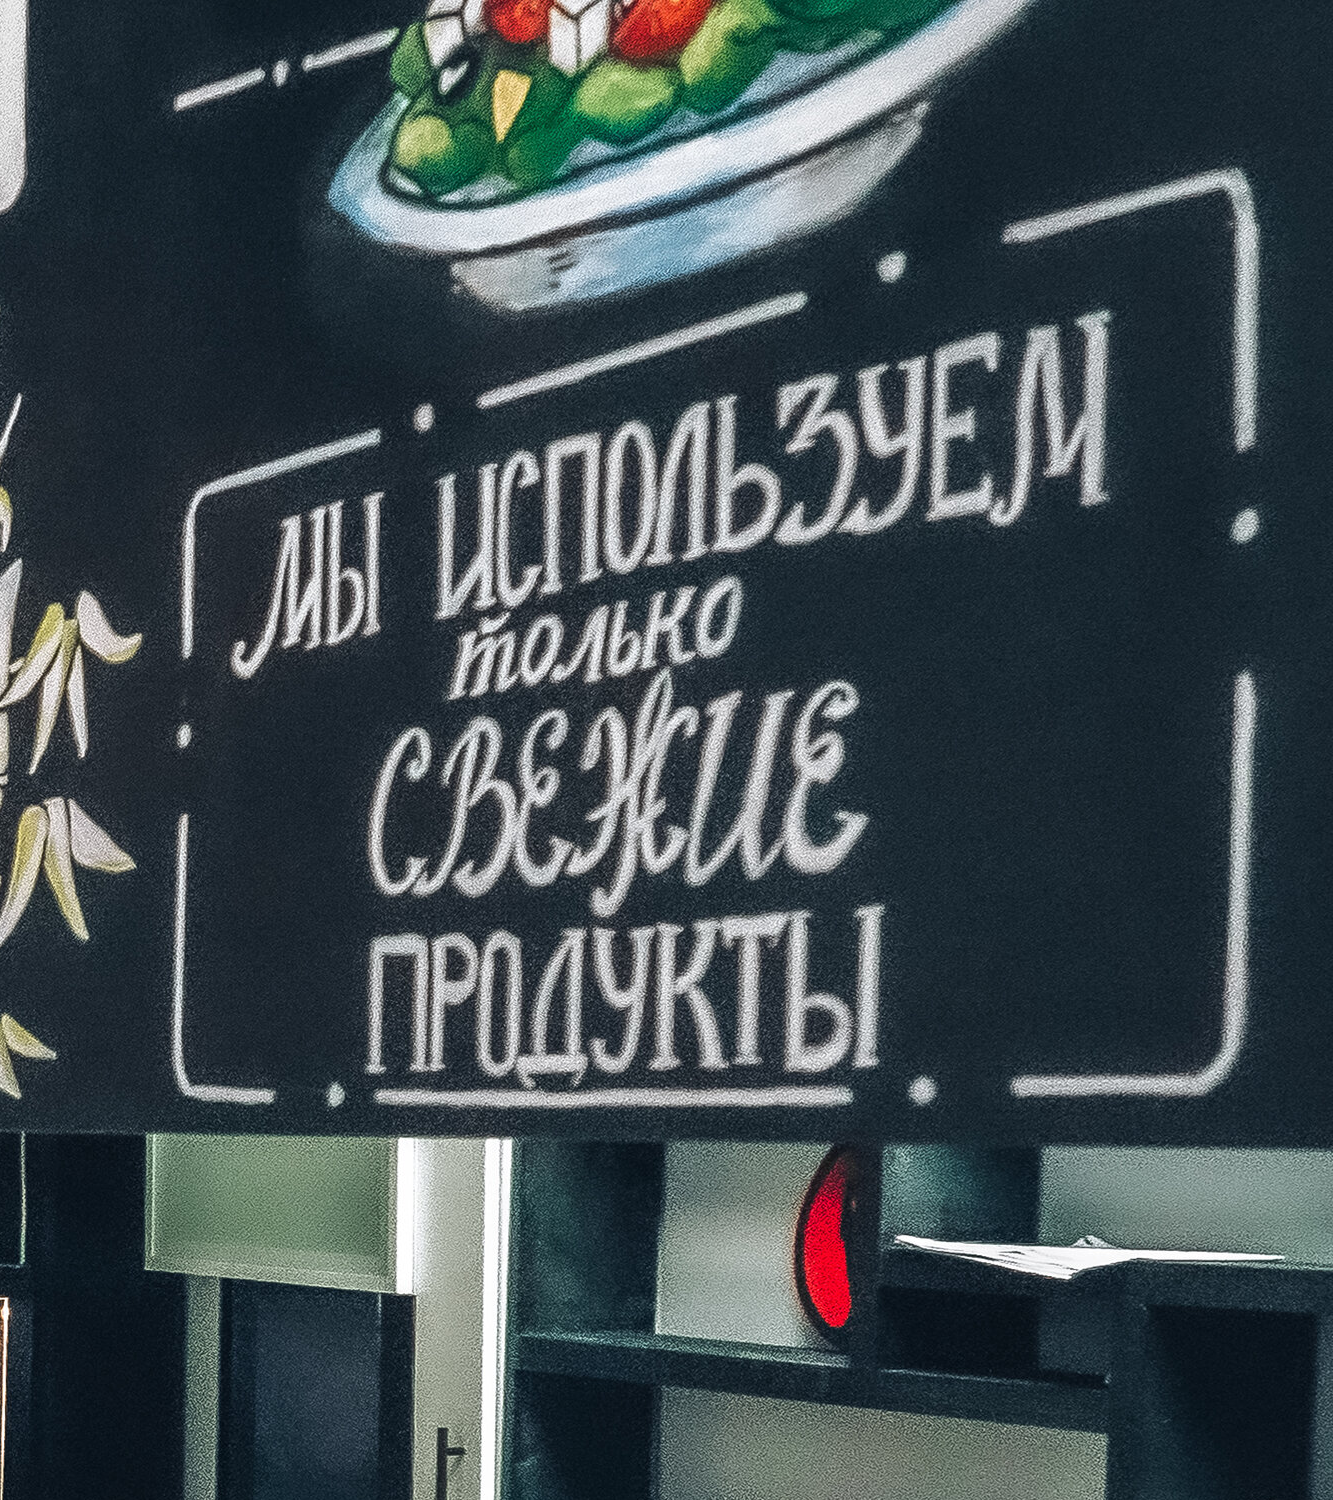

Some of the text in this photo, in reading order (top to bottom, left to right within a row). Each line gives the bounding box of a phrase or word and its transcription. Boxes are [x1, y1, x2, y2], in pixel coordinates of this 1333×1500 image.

[231, 311, 1113, 680] МЫ ИСПОЛЬЗУЕМ
[367, 672, 869, 914] СВЕЖИЕ
[365, 904, 886, 1087] ПРОДУКТЫ
